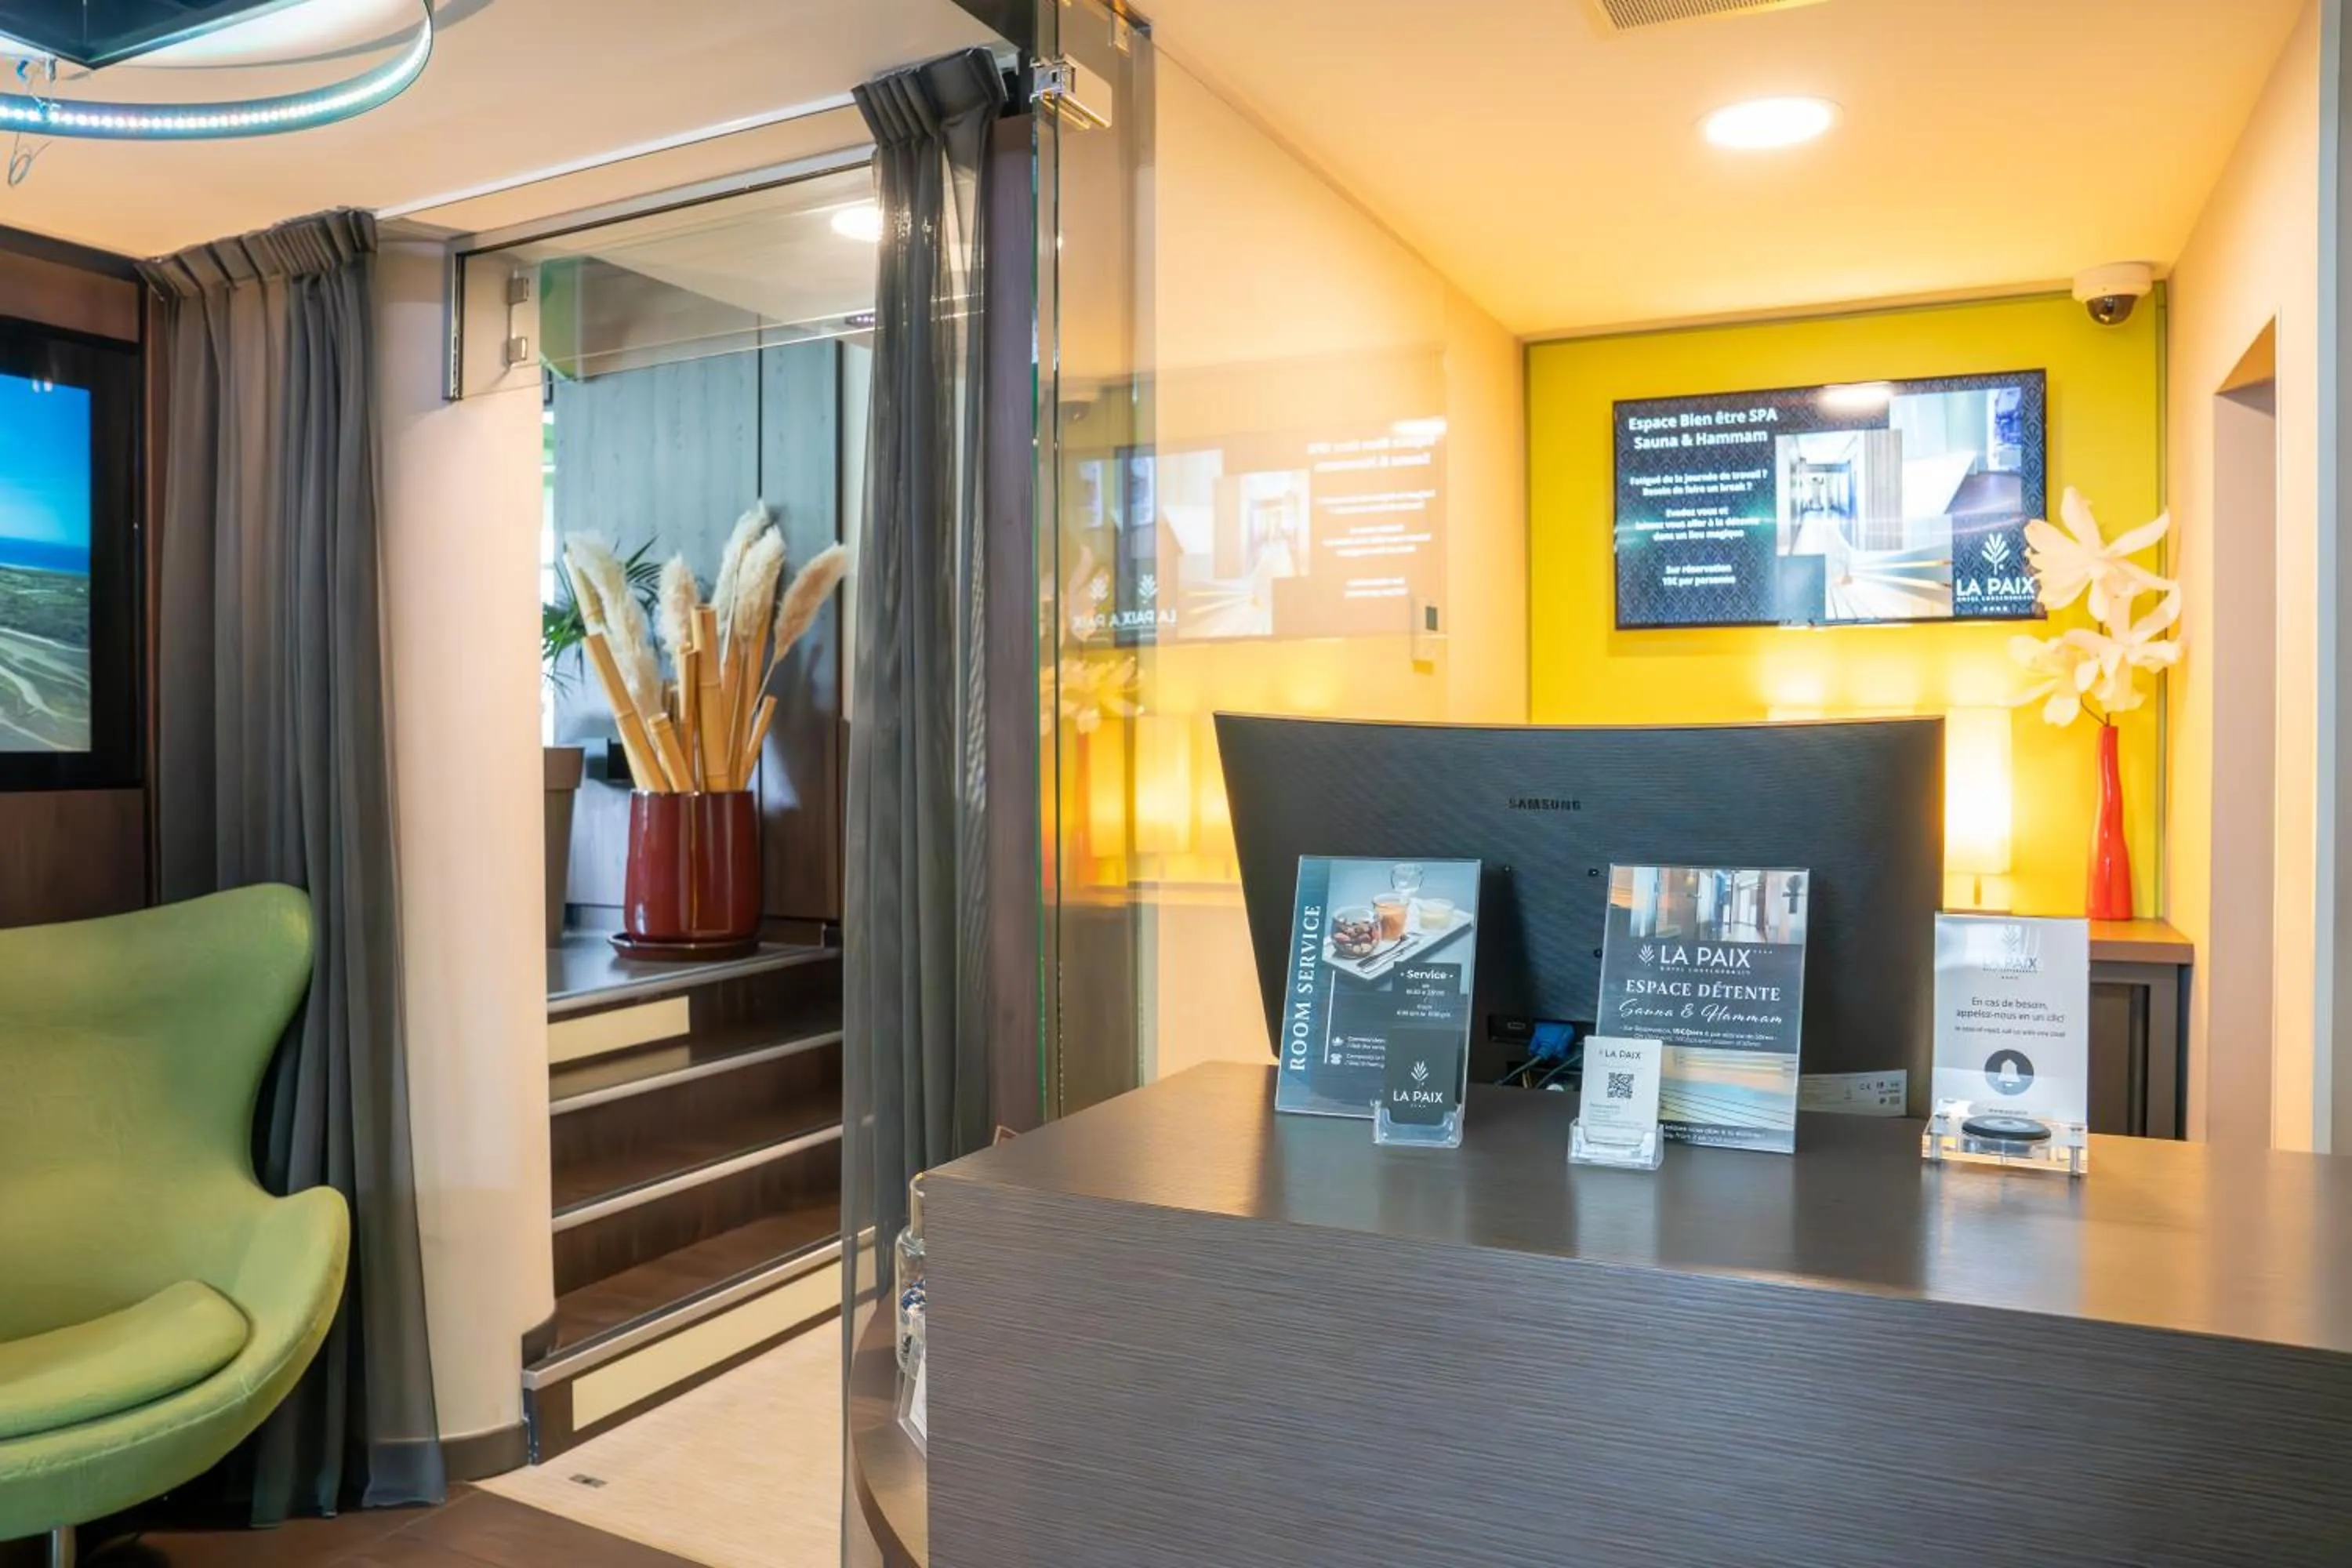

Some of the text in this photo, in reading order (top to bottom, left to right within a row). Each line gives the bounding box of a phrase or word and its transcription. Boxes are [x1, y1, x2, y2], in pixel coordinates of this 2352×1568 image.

[1628, 408, 1778, 432] Espace Bien être SPA
[1634, 430, 1768, 449] Sauna & Hammam
[1956, 577, 2034, 596] LA PAIX
[1660, 945, 1751, 968] LA PAIX
[1406, 969, 1446, 979] Service
[1290, 905, 1321, 1071] ROOM SERVICE
[1626, 979, 1781, 1001] ESPACE DÉTENTE
[1619, 998, 1783, 1023] Sauna & Hammam
[1972, 996, 1983, 1006] En
[1984, 998, 1999, 1007] cas
[2002, 998, 2013, 1007] de
[1619, 1050, 1642, 1059] PAIX
[1393, 1091, 1443, 1104] LA PAIX
